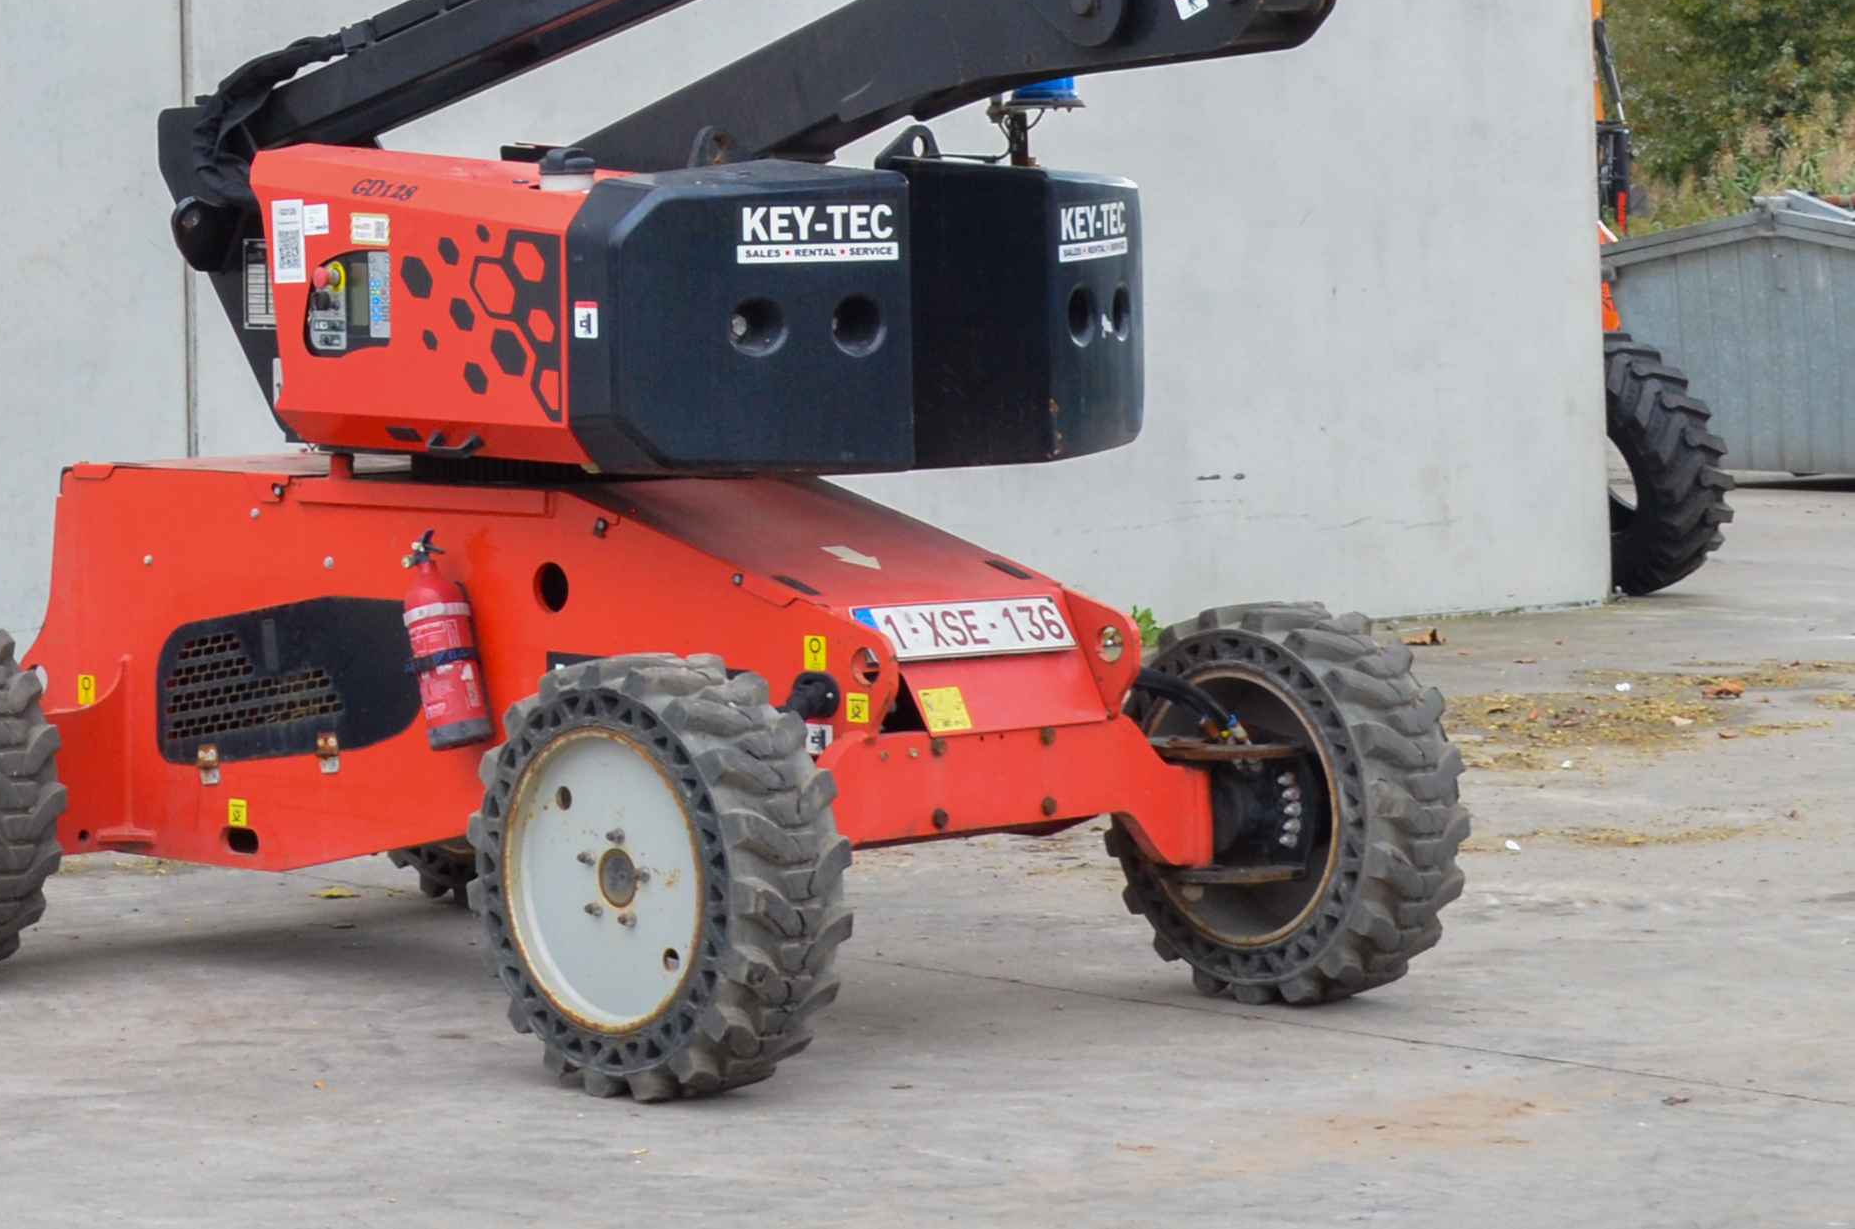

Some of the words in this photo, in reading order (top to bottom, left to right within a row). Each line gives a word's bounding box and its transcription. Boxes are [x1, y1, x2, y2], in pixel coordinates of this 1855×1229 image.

[742, 204, 894, 242] KEY-TEC
[1060, 201, 1126, 242] KEY-TEC
[745, 249, 781, 258] SALES
[794, 248, 836, 257] RENTAL
[848, 246, 893, 256] SERVICE
